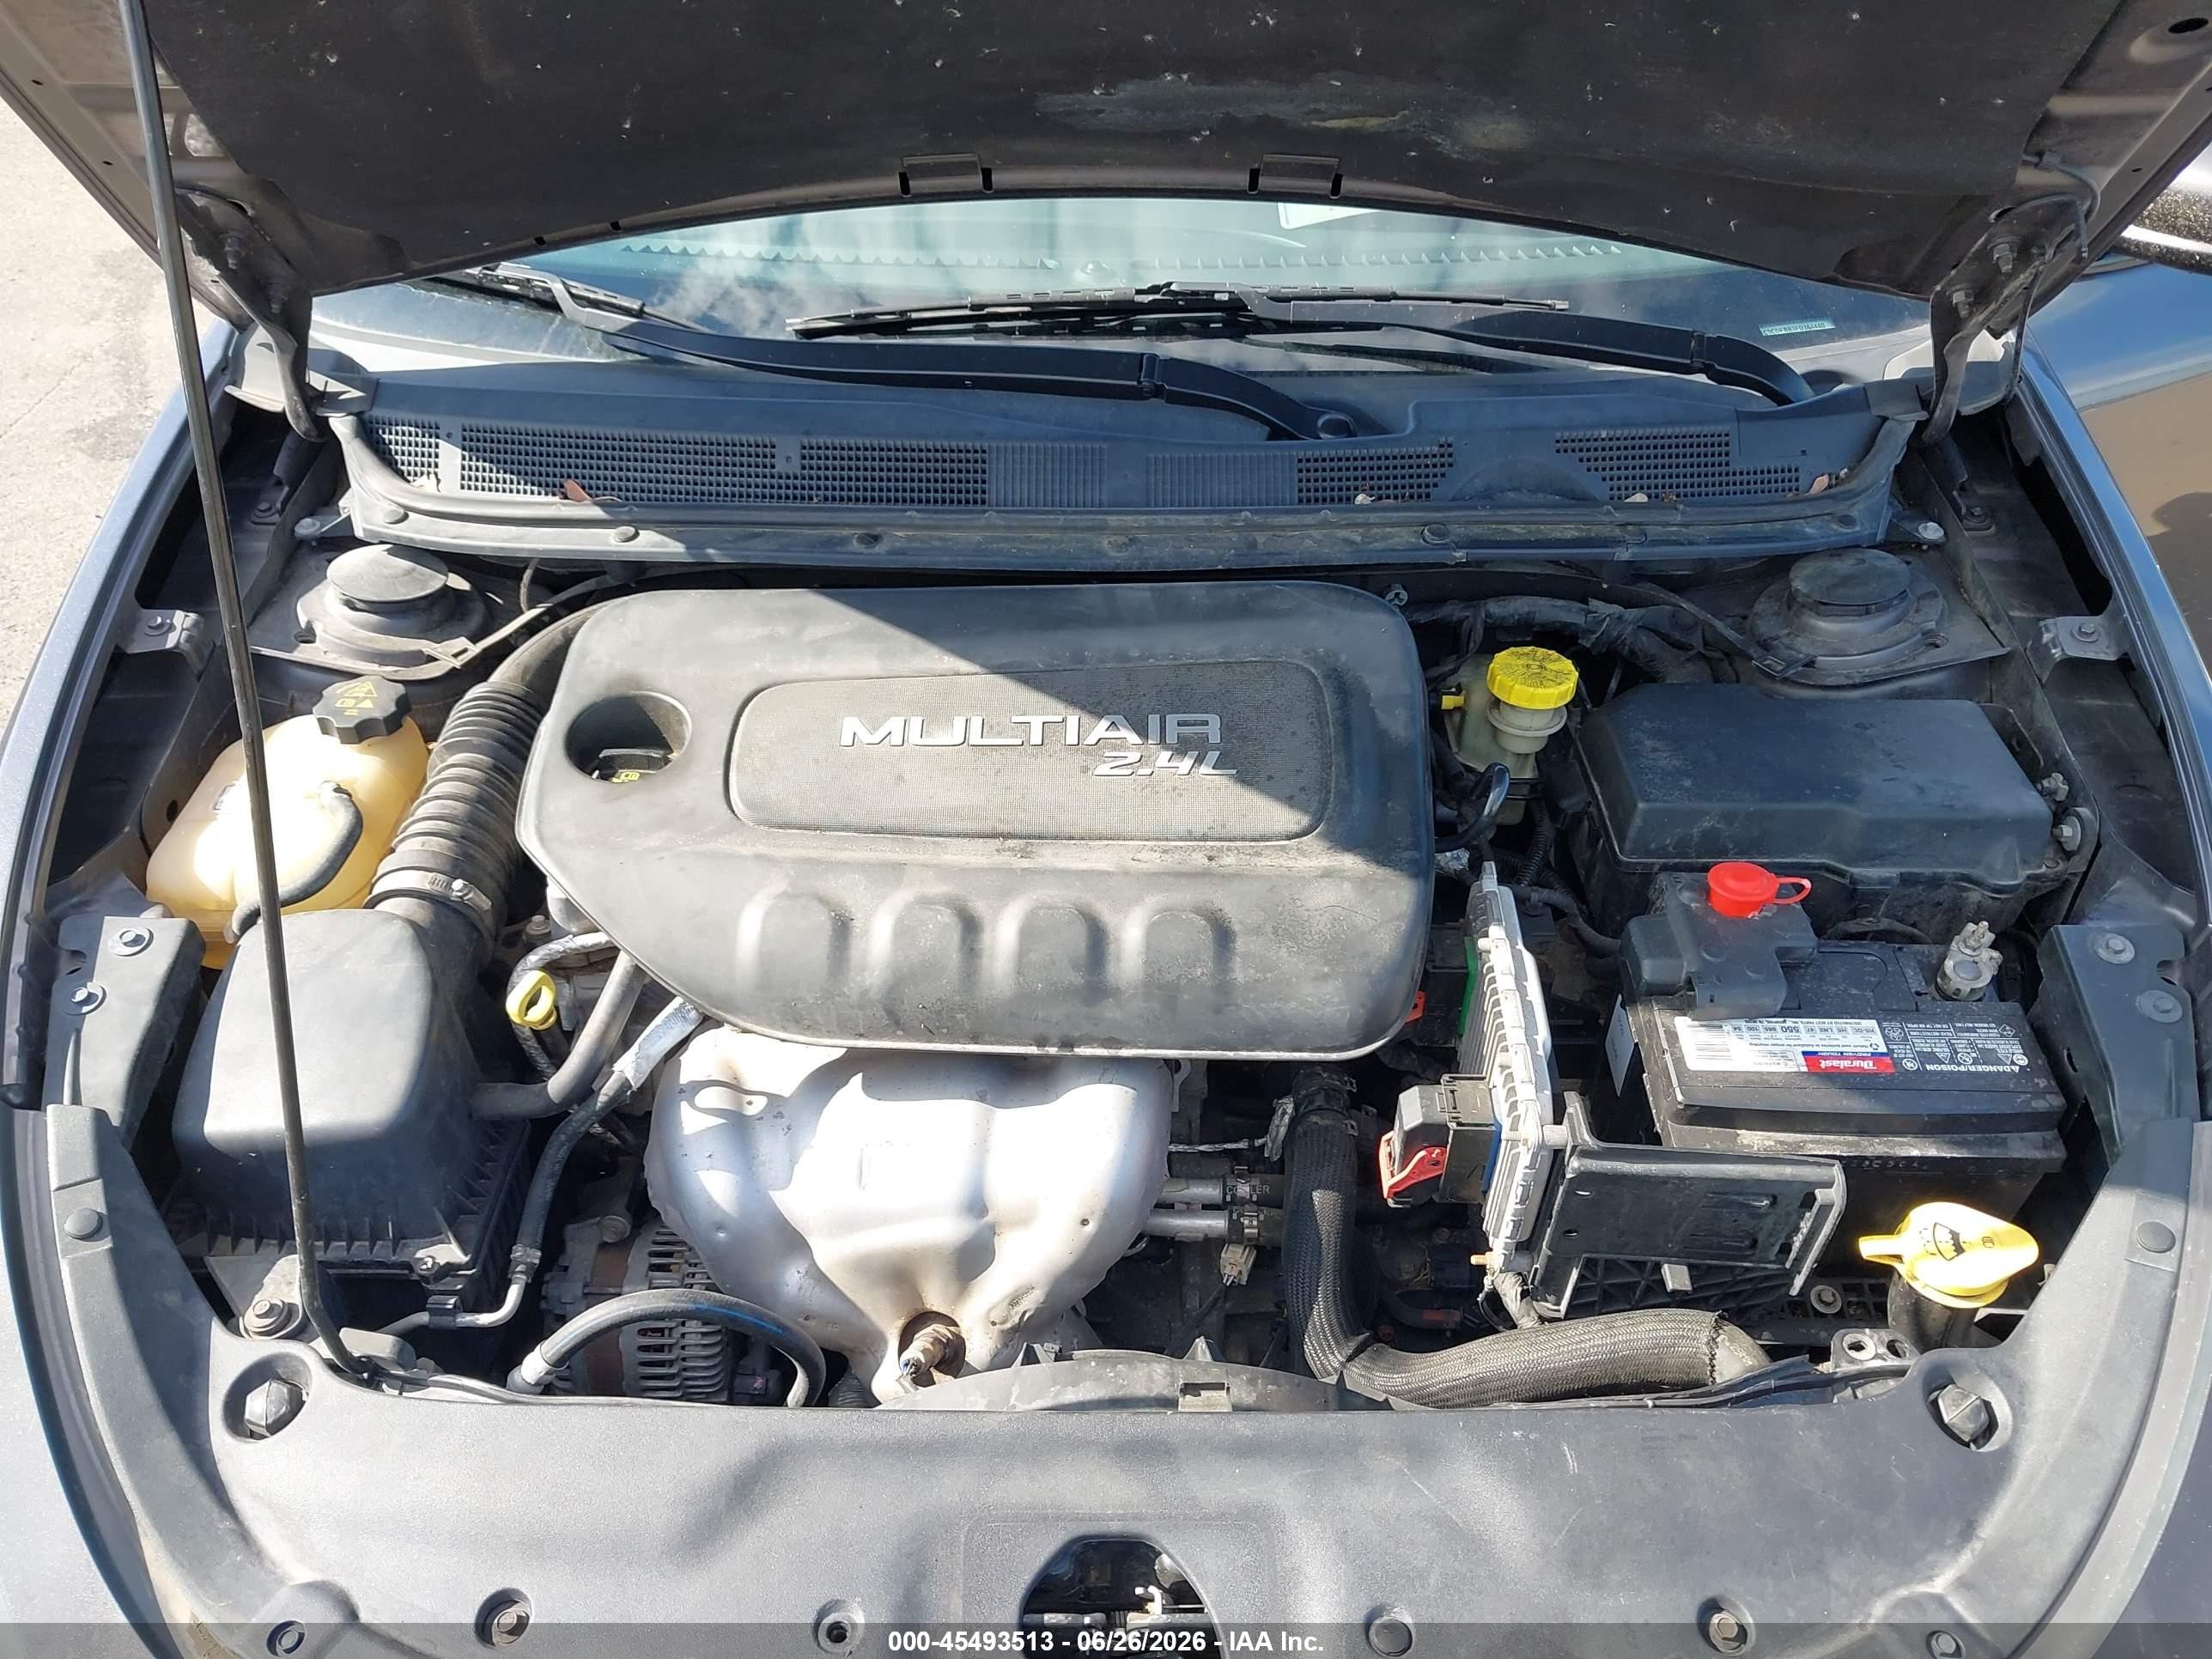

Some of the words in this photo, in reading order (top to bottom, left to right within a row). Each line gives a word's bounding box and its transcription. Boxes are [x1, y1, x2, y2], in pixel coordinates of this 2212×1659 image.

[839, 714, 1223, 746] MULTIAIR
[1092, 751, 1237, 776] 2.4L
[1819, 1060, 1878, 1070] Duralast
[1925, 1064, 2012, 1073] DANGER/POISON
